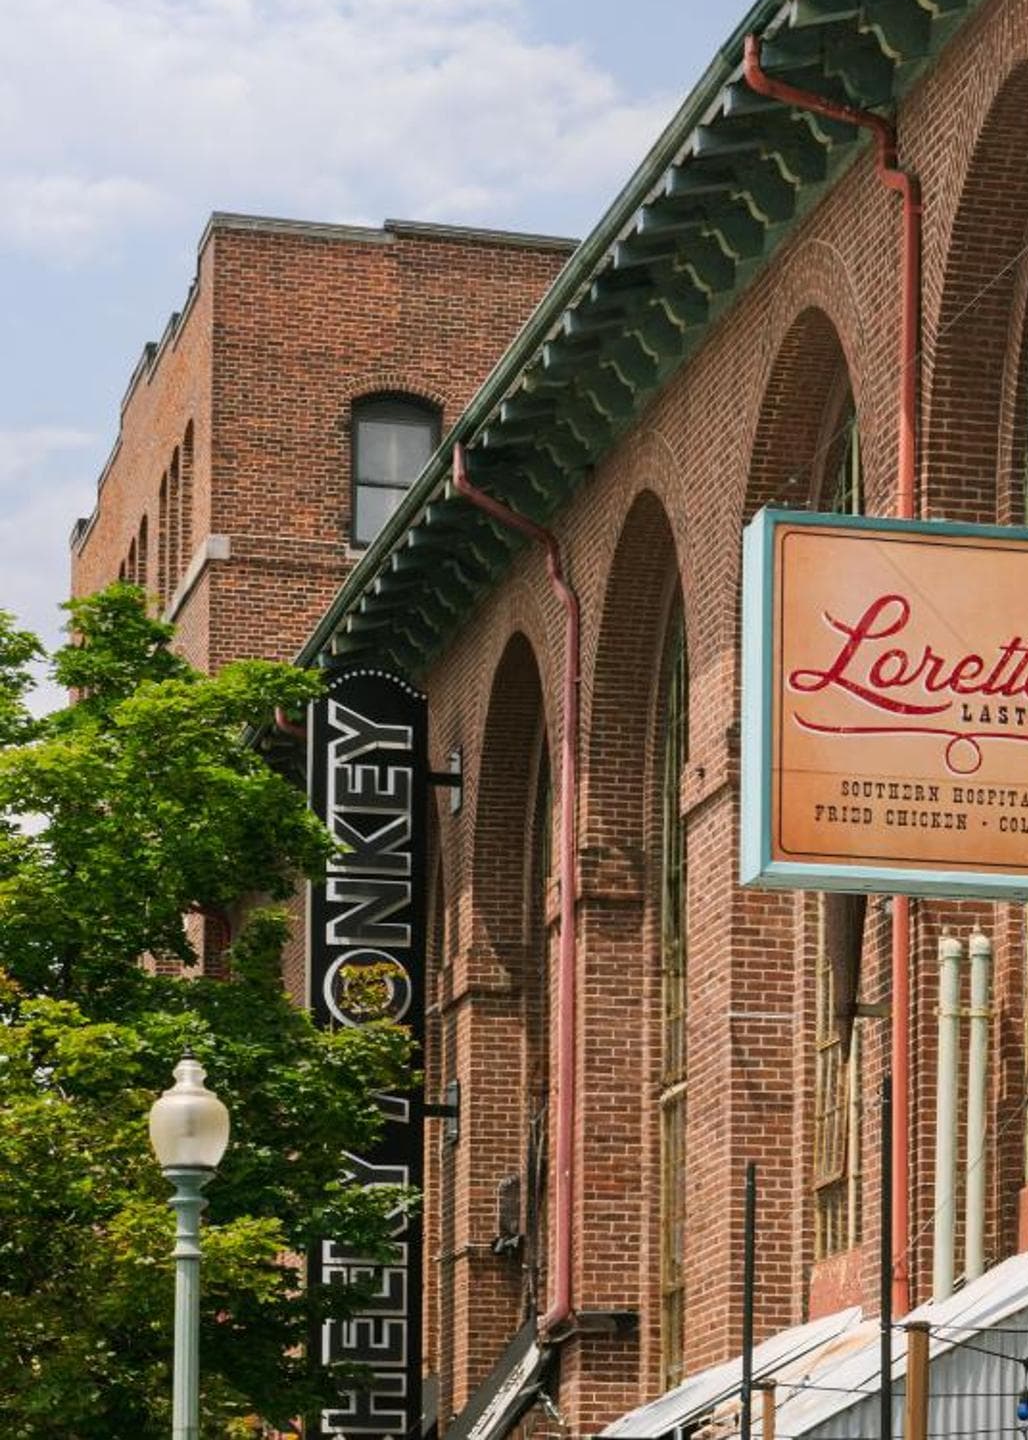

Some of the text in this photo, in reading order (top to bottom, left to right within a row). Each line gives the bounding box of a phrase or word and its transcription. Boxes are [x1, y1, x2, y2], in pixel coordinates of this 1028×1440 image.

[961, 703, 1027, 728] LAST
[840, 780, 940, 803] SOUTHERN
[814, 804, 873, 825] FRIED
[885, 809, 968, 831] CHICKEN
[322, 698, 413, 1123] ONKEY
